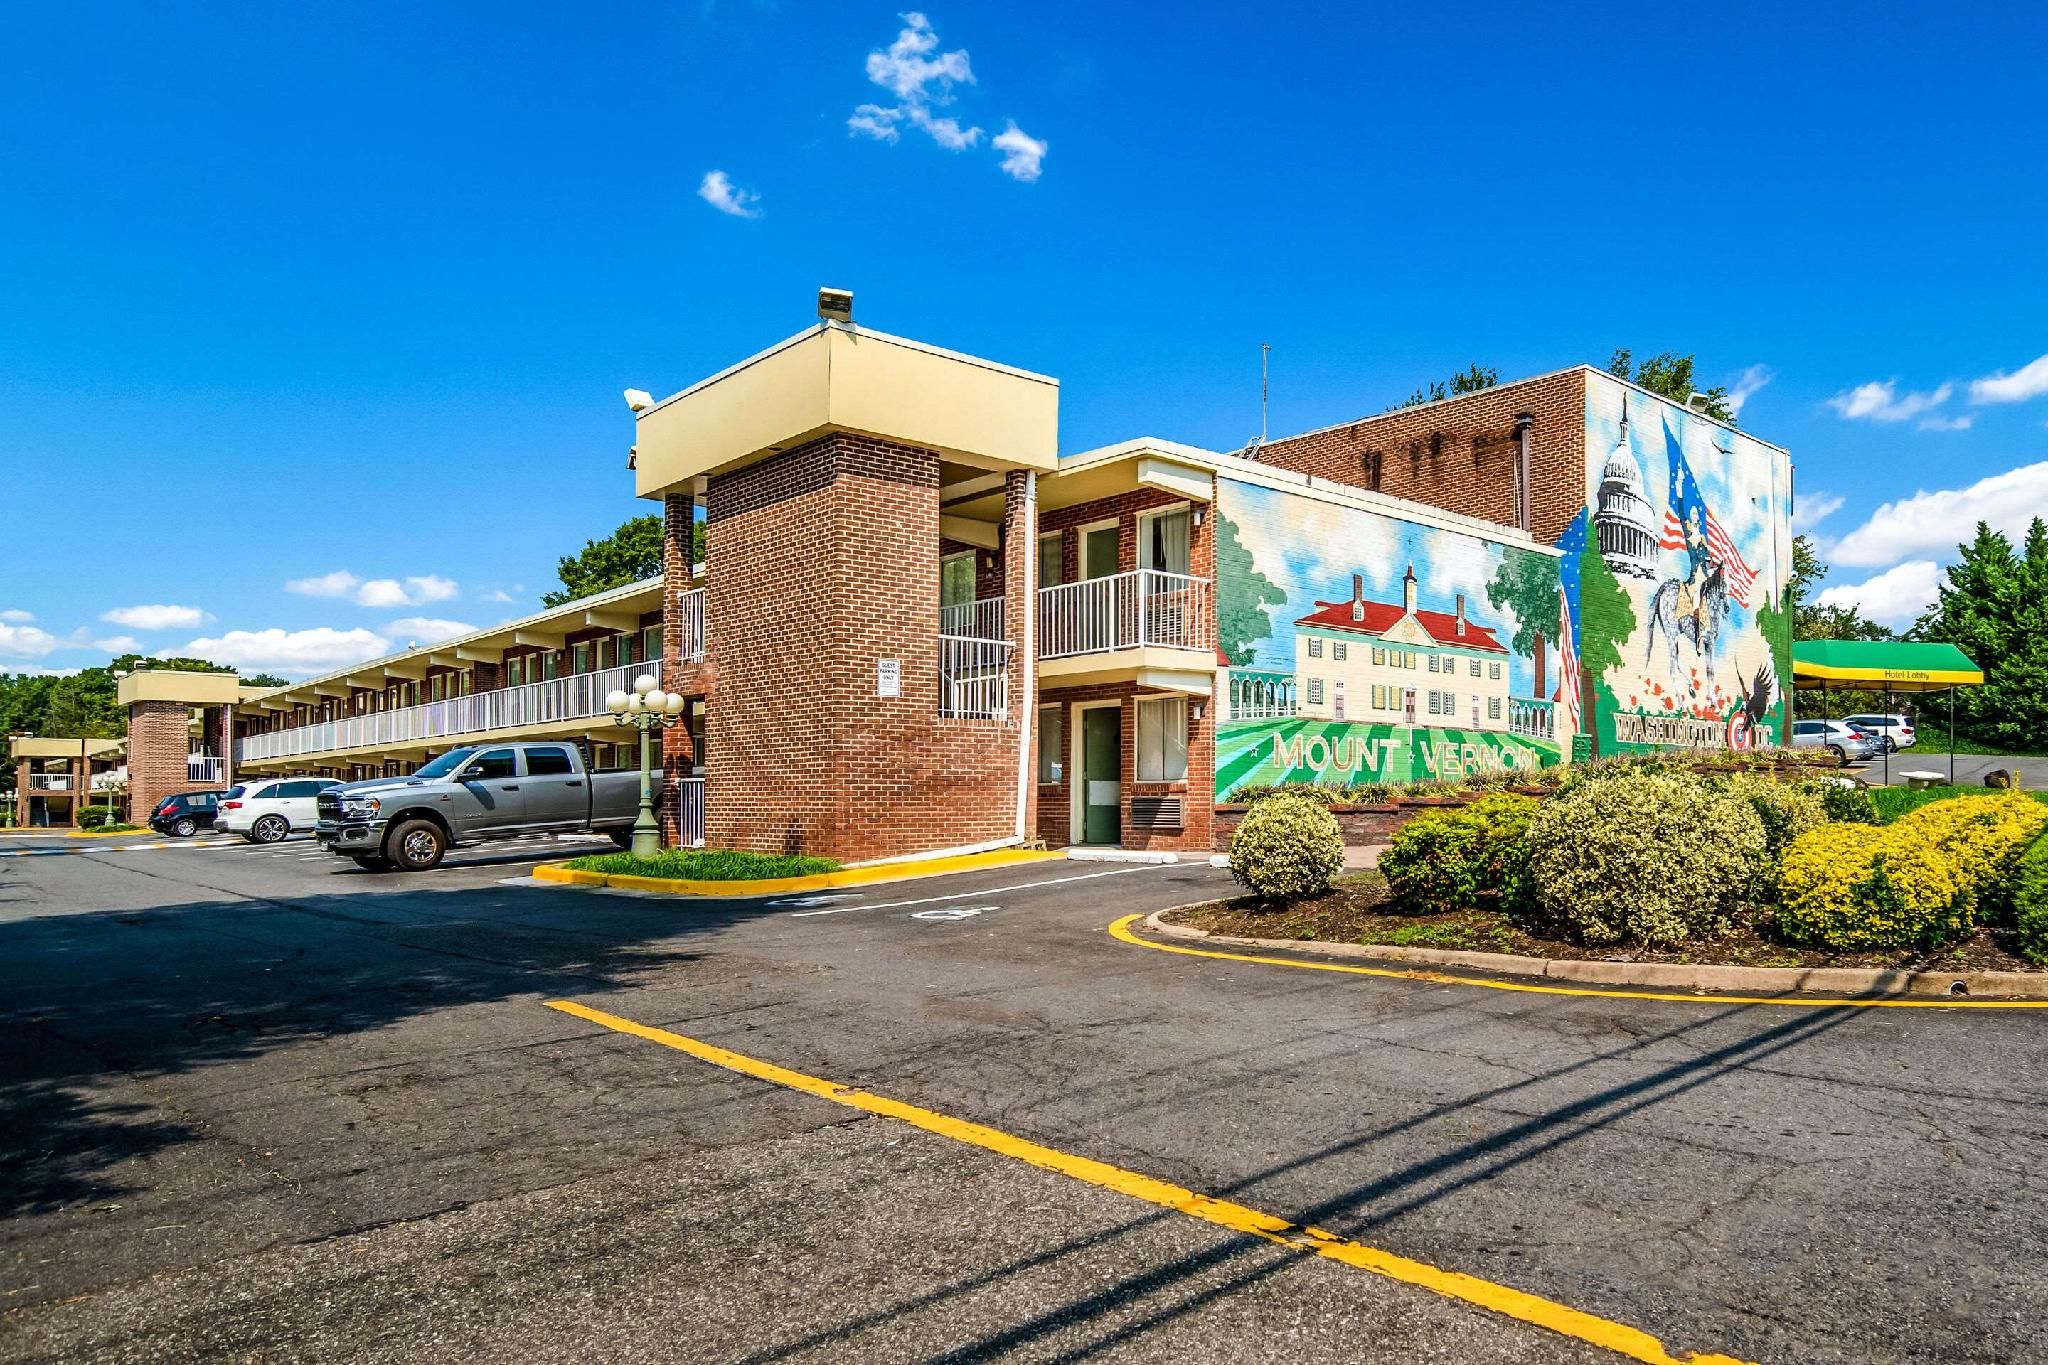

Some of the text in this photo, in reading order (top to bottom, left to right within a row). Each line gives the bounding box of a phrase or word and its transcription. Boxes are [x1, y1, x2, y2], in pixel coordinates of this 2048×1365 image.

[1884, 670, 1930, 681] Hotel Lobby
[1613, 712, 1774, 750] WASHINGTON DC
[1273, 732, 1536, 779] MOUNT VERNON
